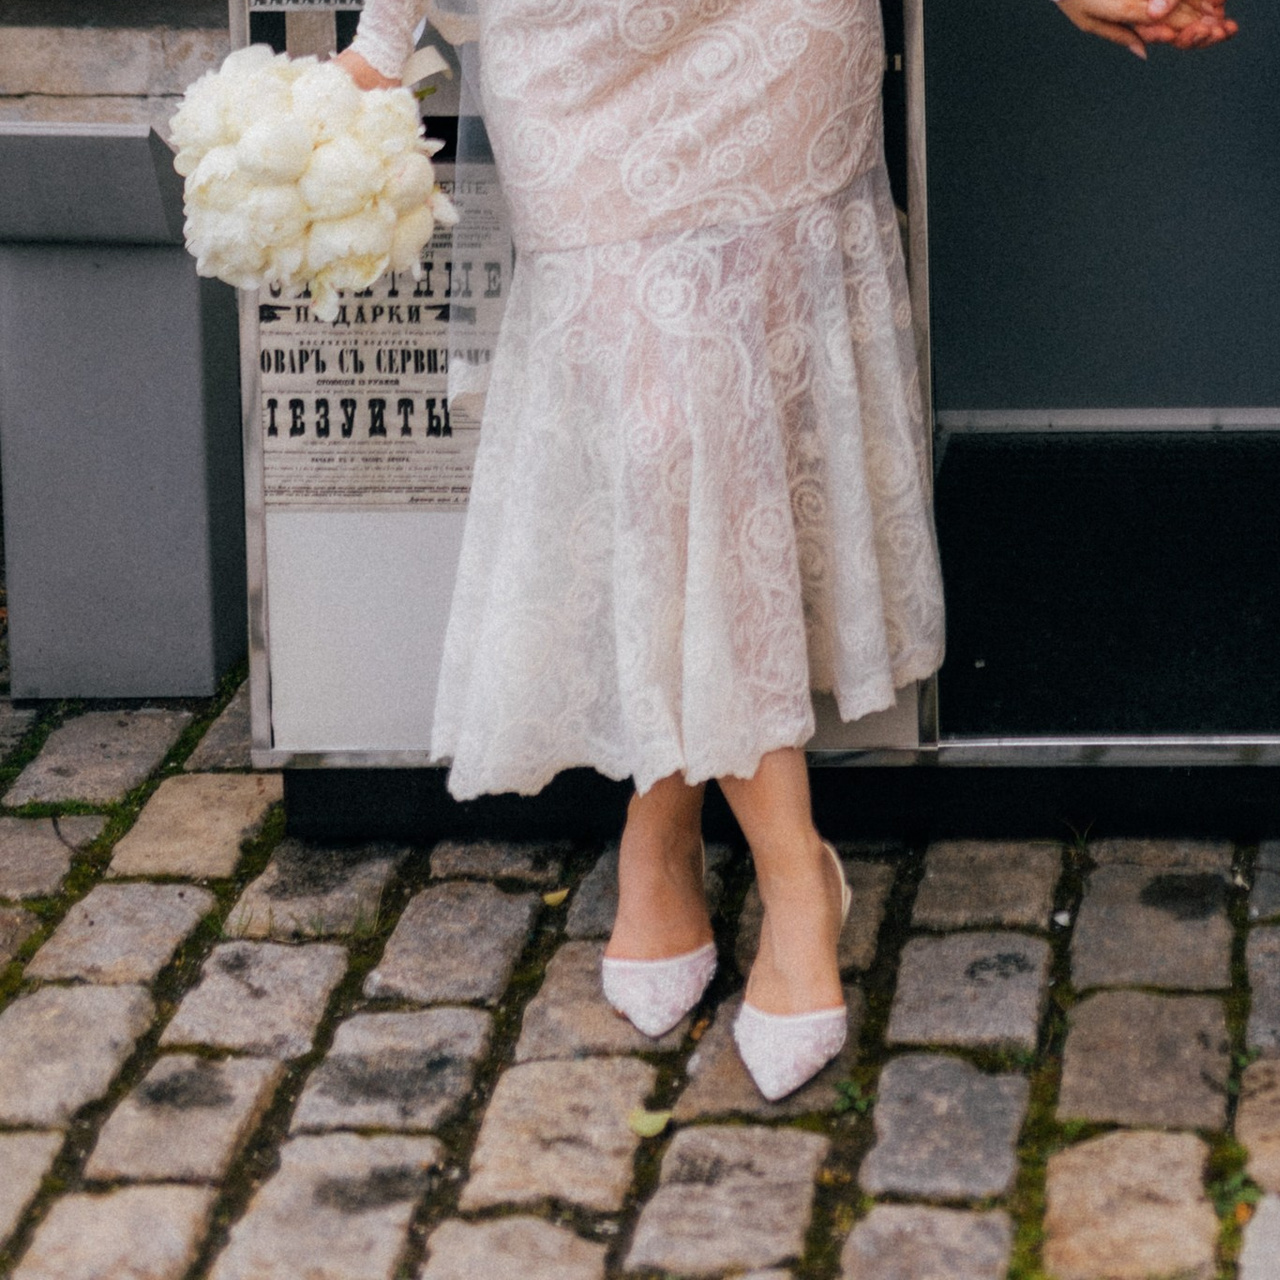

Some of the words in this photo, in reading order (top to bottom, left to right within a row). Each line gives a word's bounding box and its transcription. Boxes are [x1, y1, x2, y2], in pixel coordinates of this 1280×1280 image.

[295, 304, 422, 329] ПДАРКИ
[260, 348, 327, 374] ОВАРЪ
[338, 347, 365, 374] СЪ
